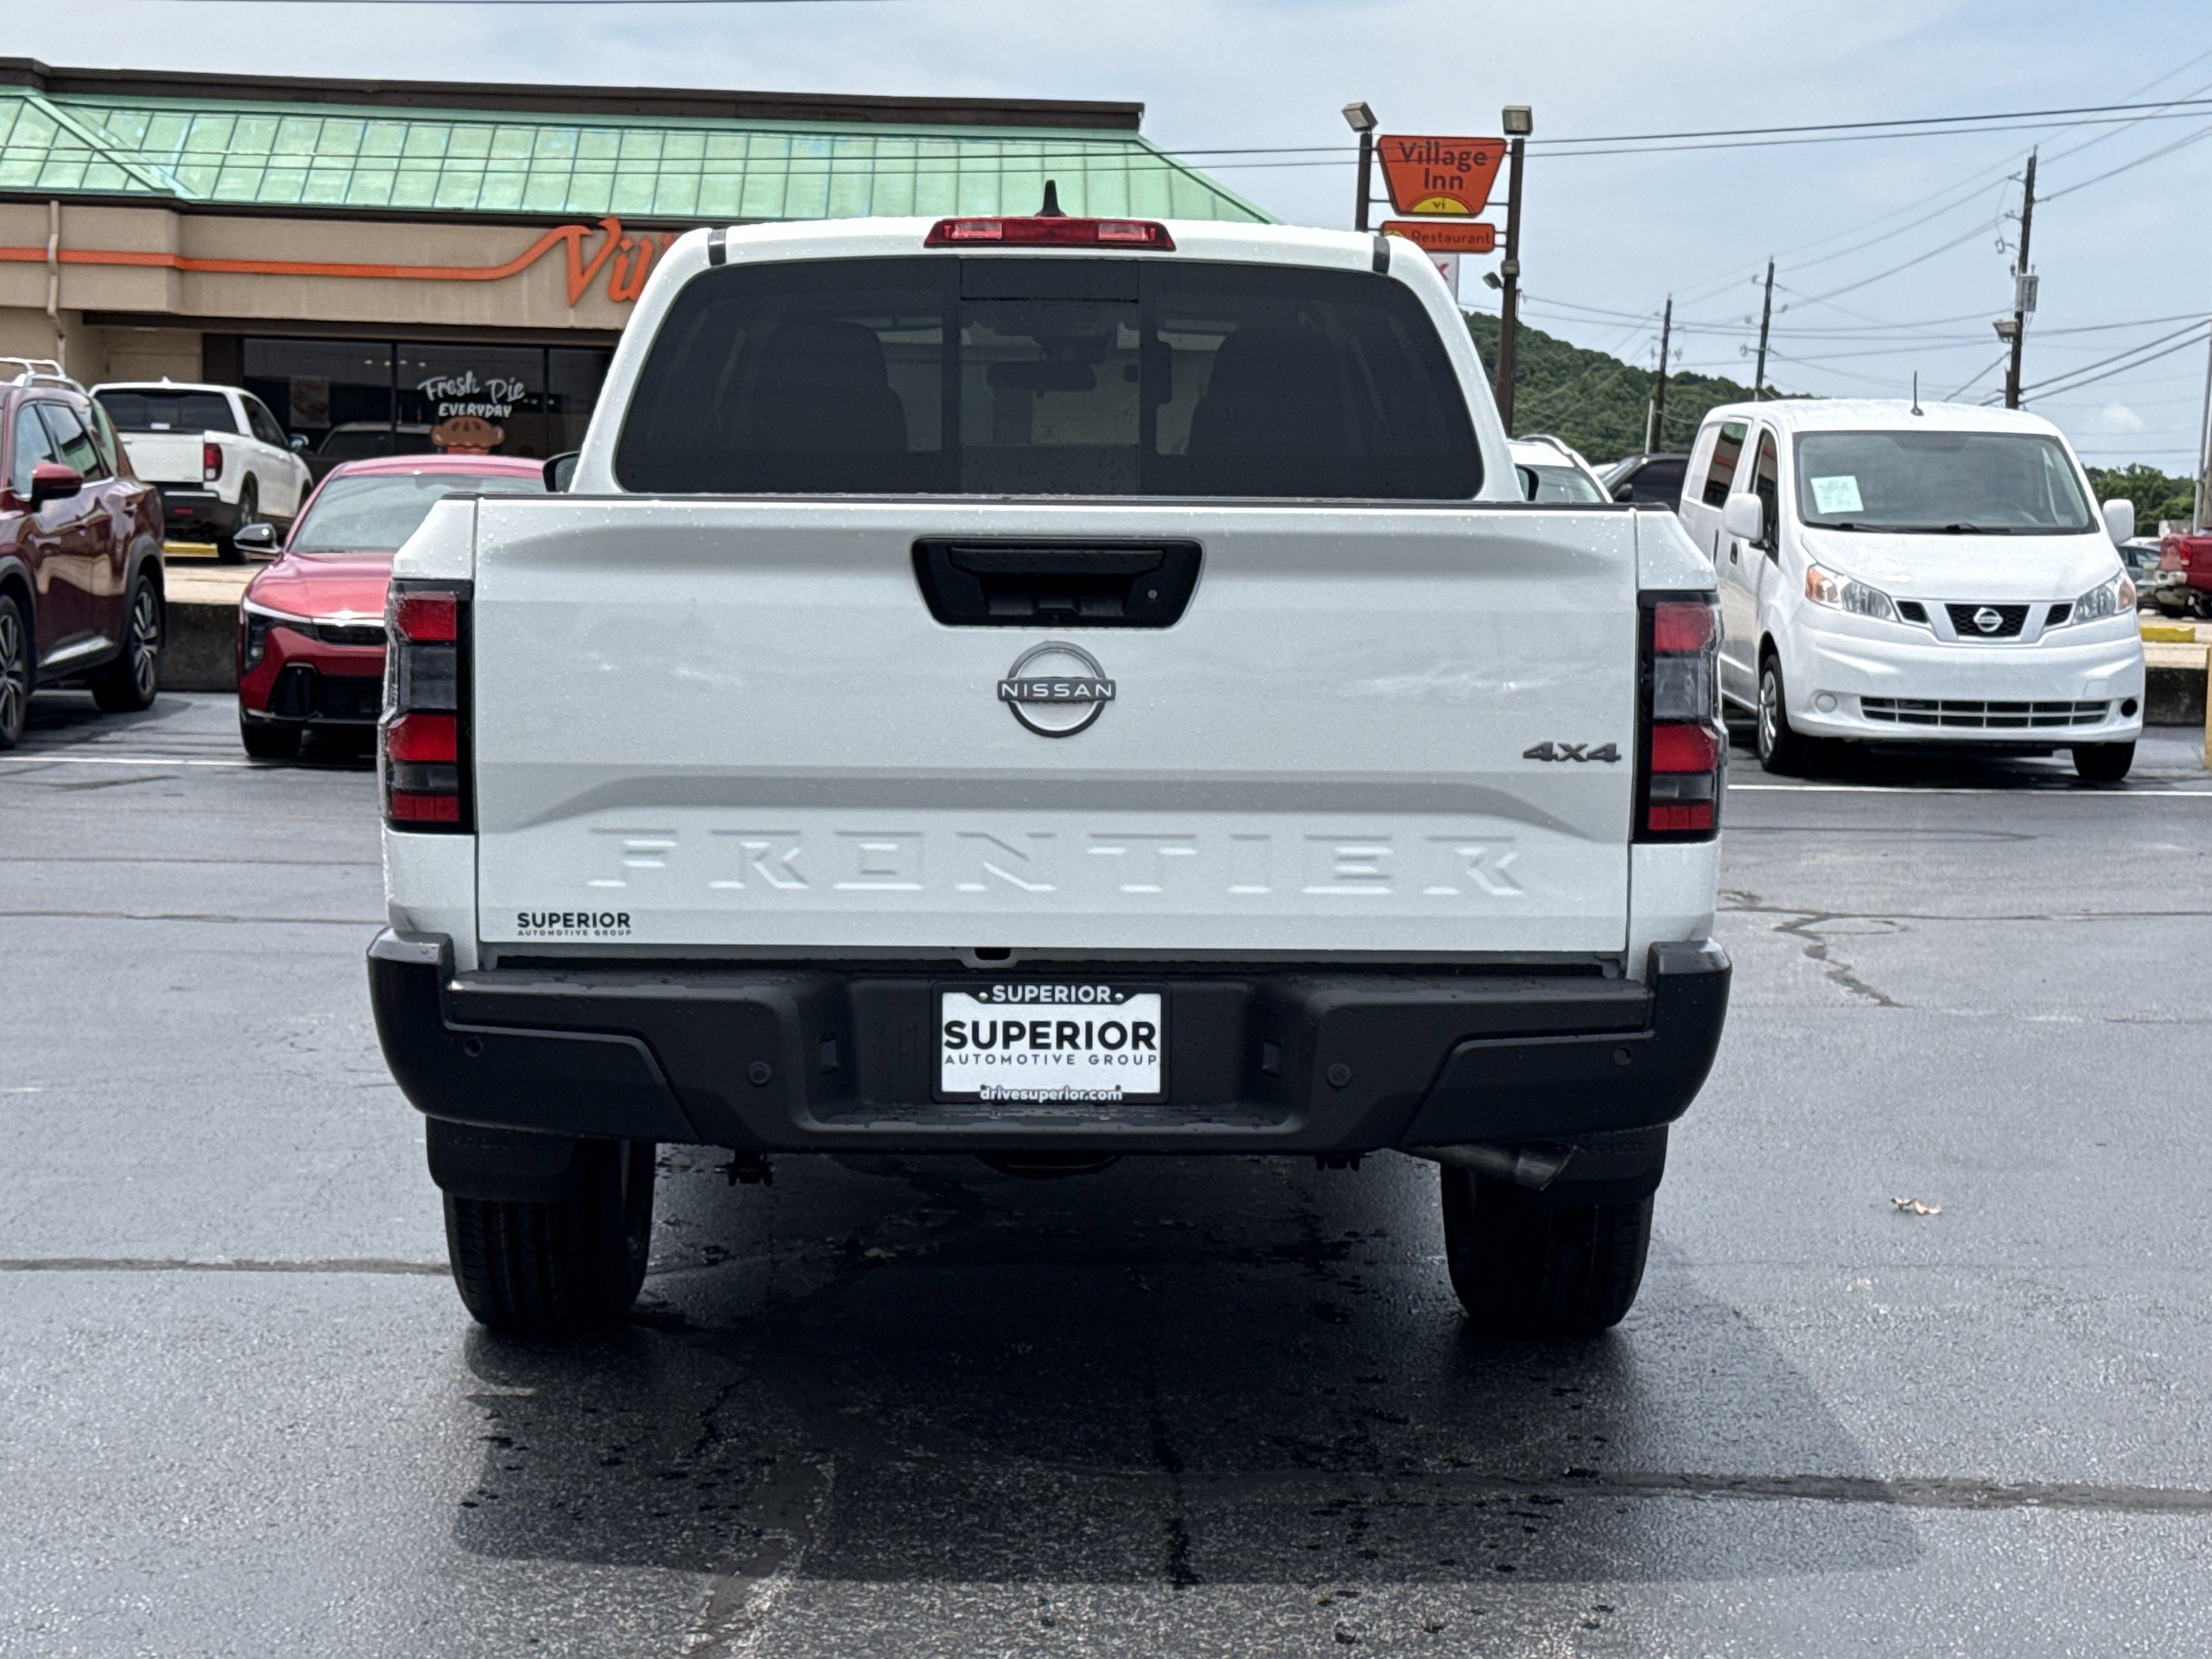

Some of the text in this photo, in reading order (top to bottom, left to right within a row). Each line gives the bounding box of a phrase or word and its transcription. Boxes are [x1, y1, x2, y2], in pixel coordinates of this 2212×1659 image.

[1398, 141, 1488, 172] Village
[1424, 168, 1463, 190] Inn
[1432, 199, 1446, 210] vi
[1412, 230, 1491, 245] Restaurant
[416, 370, 526, 404] Fresh Pie
[438, 402, 513, 418] EVERYDAY
[1001, 683, 1112, 697] NISSAN
[588, 827, 1525, 896] FRONTIER
[517, 912, 631, 928] SUPERIOR
[992, 985, 1111, 1003] SUPERIOR
[944, 1020, 1157, 1051] SUPERIOR
[944, 1053, 1158, 1065] AUTOMOTIVE GROUP
[980, 1085, 1123, 1103] drivesuperior.com
